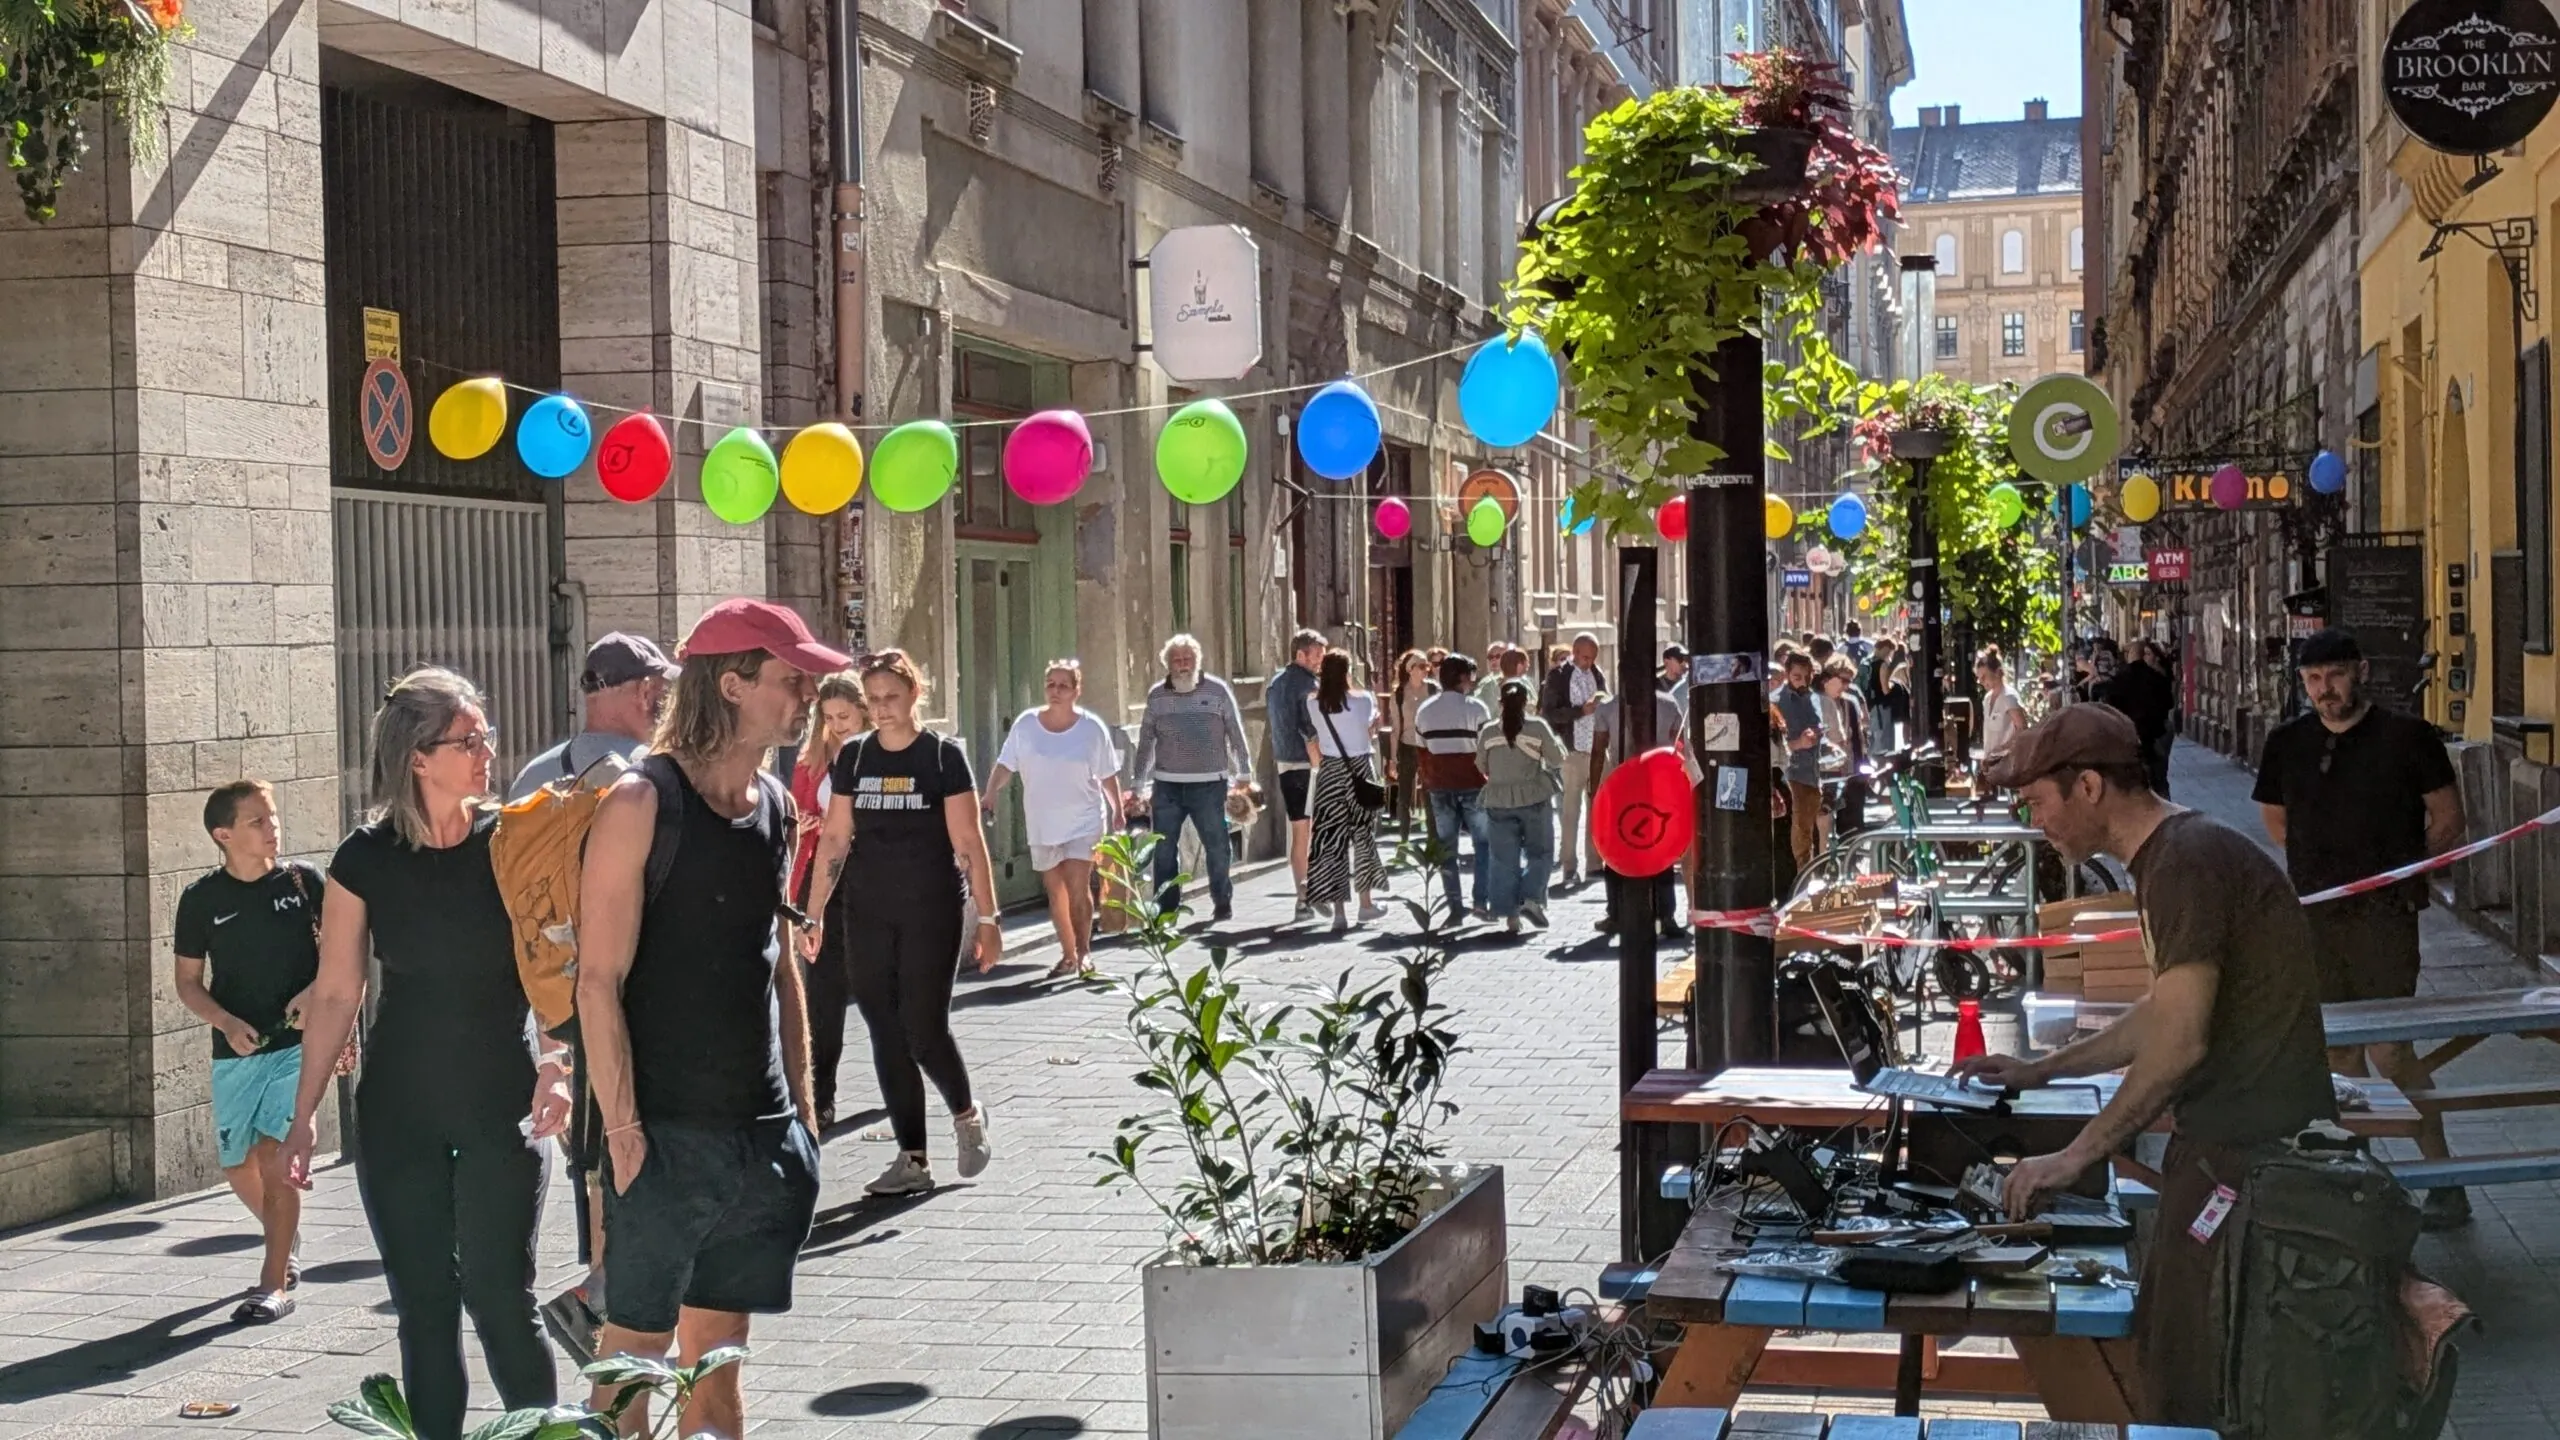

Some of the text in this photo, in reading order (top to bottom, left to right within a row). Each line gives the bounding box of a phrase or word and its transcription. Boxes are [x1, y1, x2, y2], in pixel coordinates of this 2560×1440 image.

[2464, 39, 2486, 50] THE
[2398, 51, 2552, 78] BROOKLYN
[2462, 81, 2486, 92] BAR
[2155, 552, 2184, 565] ATM
[1785, 574, 1809, 583] ATM
[2109, 565, 2148, 580] ABC
[883, 794, 904, 810] WITH
